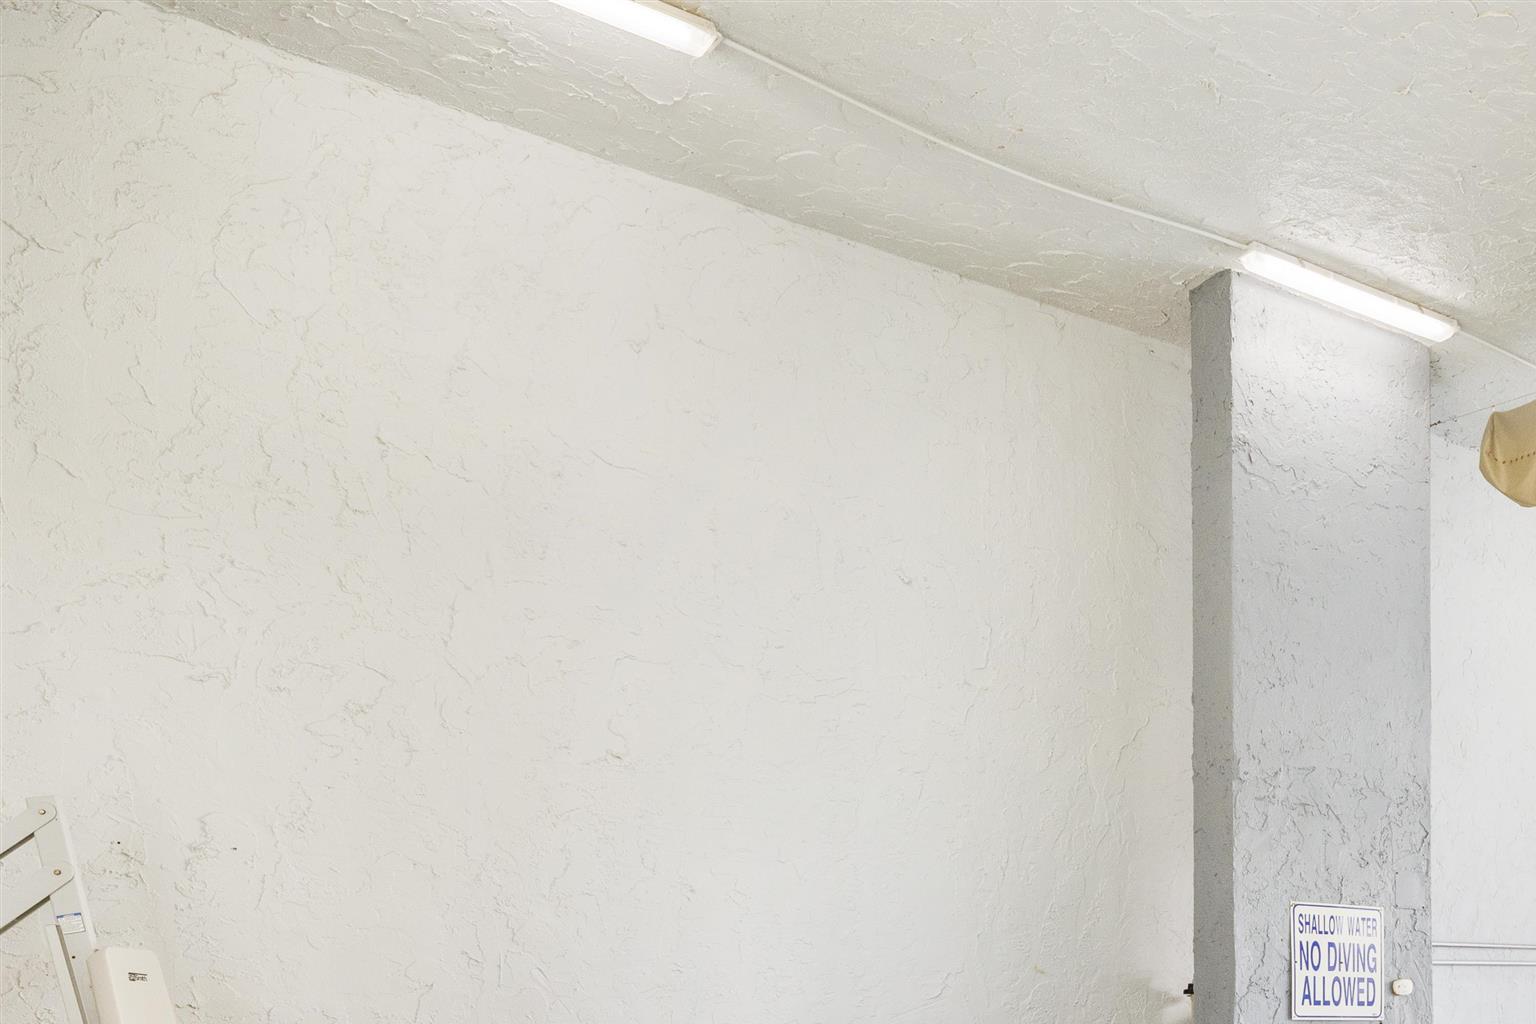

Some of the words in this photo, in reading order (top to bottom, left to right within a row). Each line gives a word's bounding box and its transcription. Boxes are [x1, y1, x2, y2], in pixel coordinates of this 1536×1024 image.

[1298, 913, 1344, 935] SHALLOW
[1348, 917, 1377, 937] WATER
[1300, 940, 1321, 971] NO
[1328, 941, 1377, 973] DIVING
[1301, 976, 1376, 1006] ALLOWED
